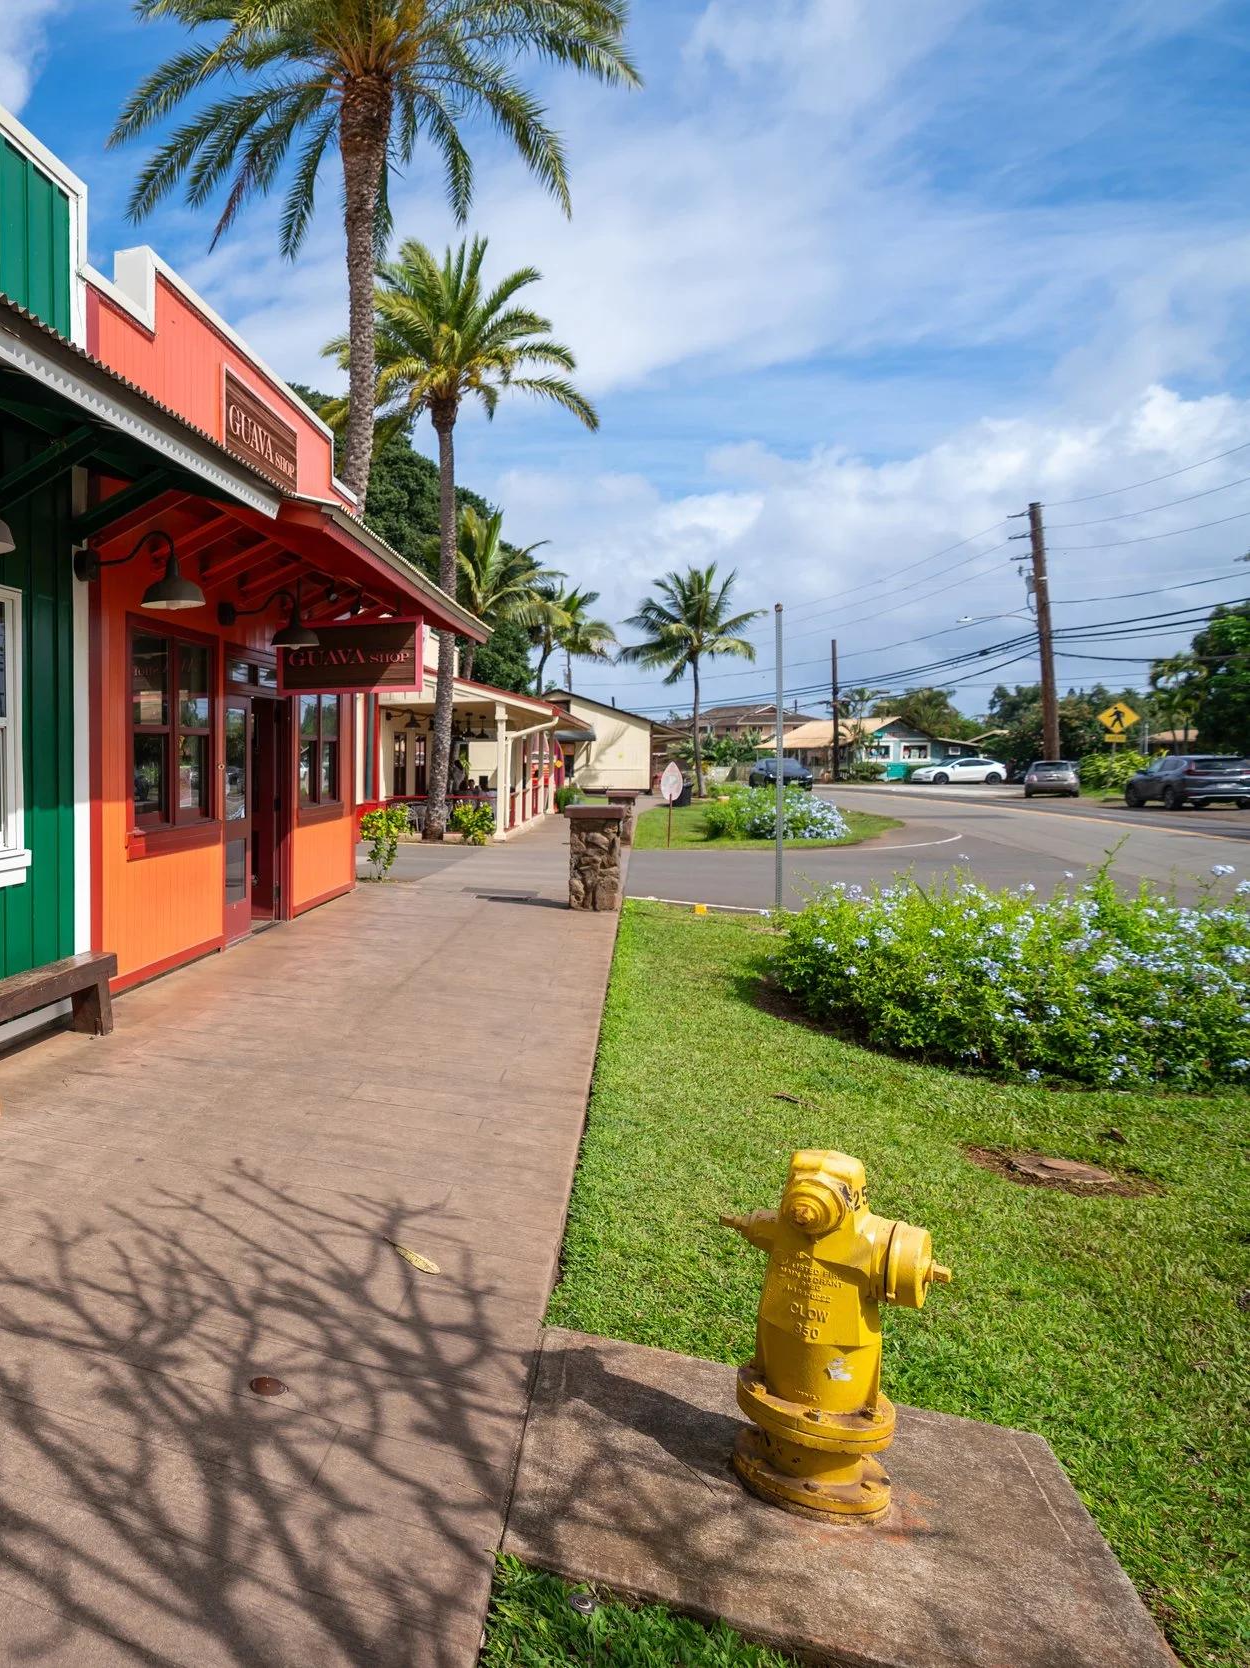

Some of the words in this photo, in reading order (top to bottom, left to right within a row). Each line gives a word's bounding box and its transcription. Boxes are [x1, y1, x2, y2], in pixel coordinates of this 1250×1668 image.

[229, 404, 275, 464] GUAVA
[275, 452, 294, 478] SHOP
[288, 648, 365, 667] GUAVA
[369, 652, 410, 663] SHOP
[790, 1301, 830, 1323] CLOW
